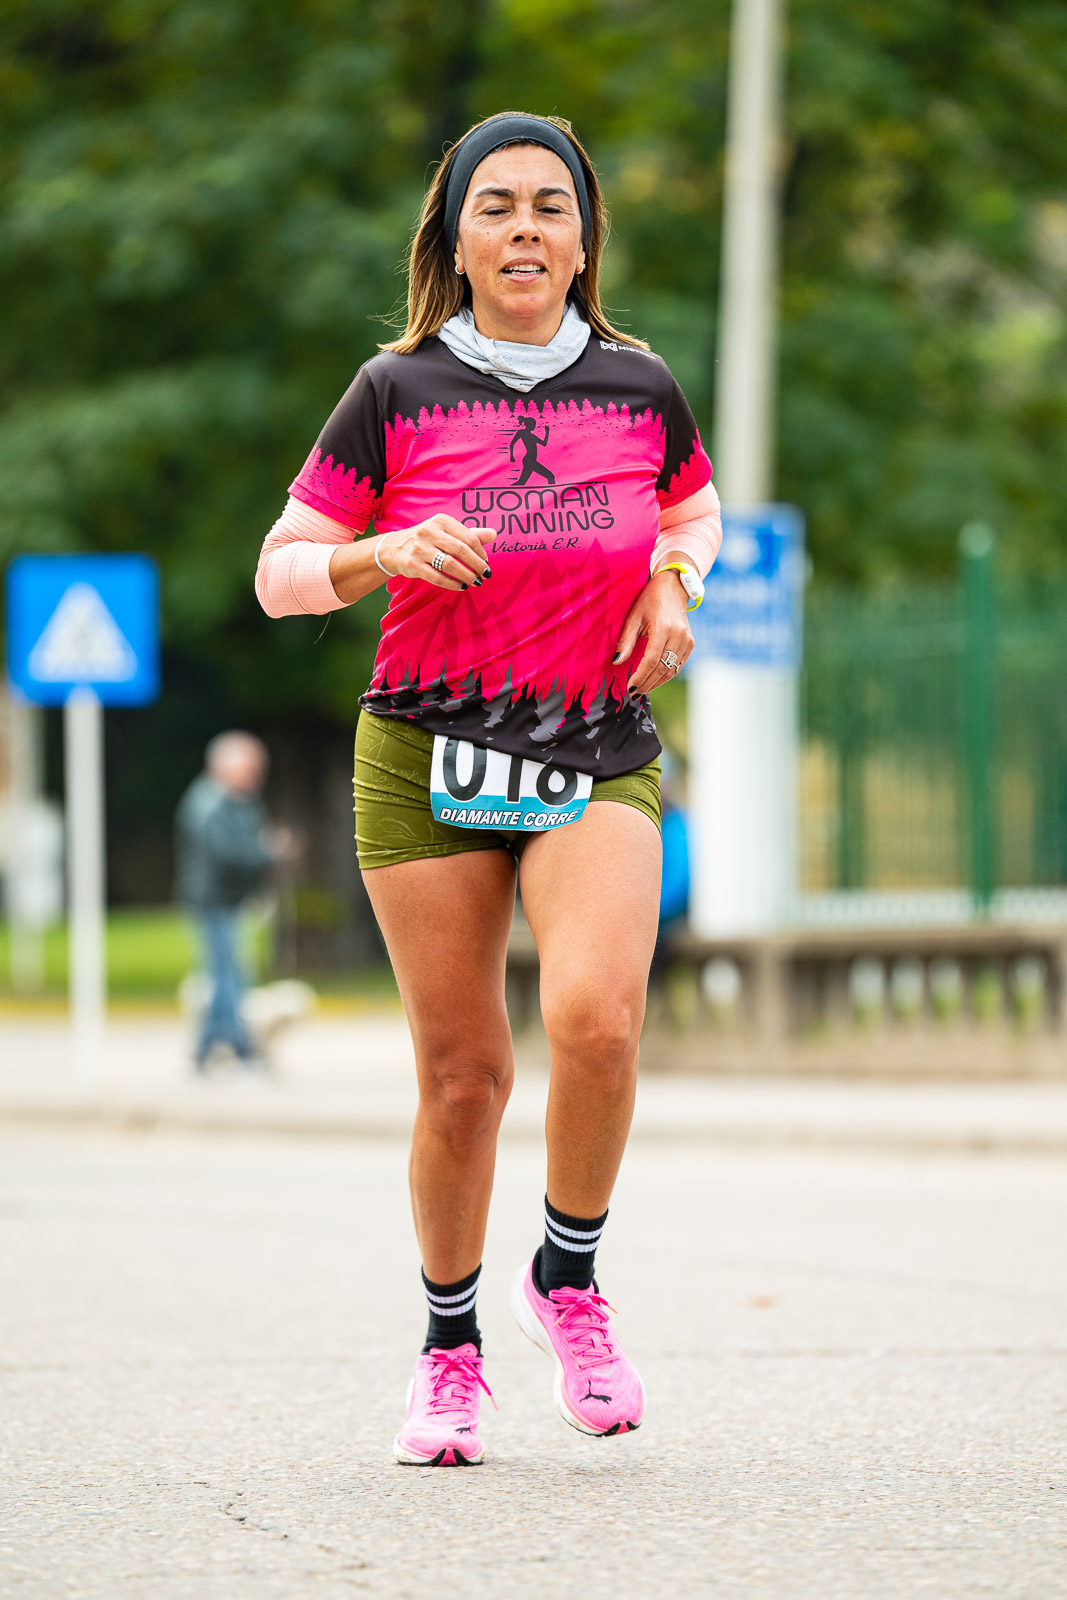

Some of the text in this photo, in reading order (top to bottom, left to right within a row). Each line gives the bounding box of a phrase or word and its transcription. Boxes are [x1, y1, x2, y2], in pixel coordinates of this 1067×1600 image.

[461, 485, 609, 514] WOMAN
[492, 537, 581, 554] Victoria E.R.
[440, 808, 581, 827] DIAMANTE CORRE
